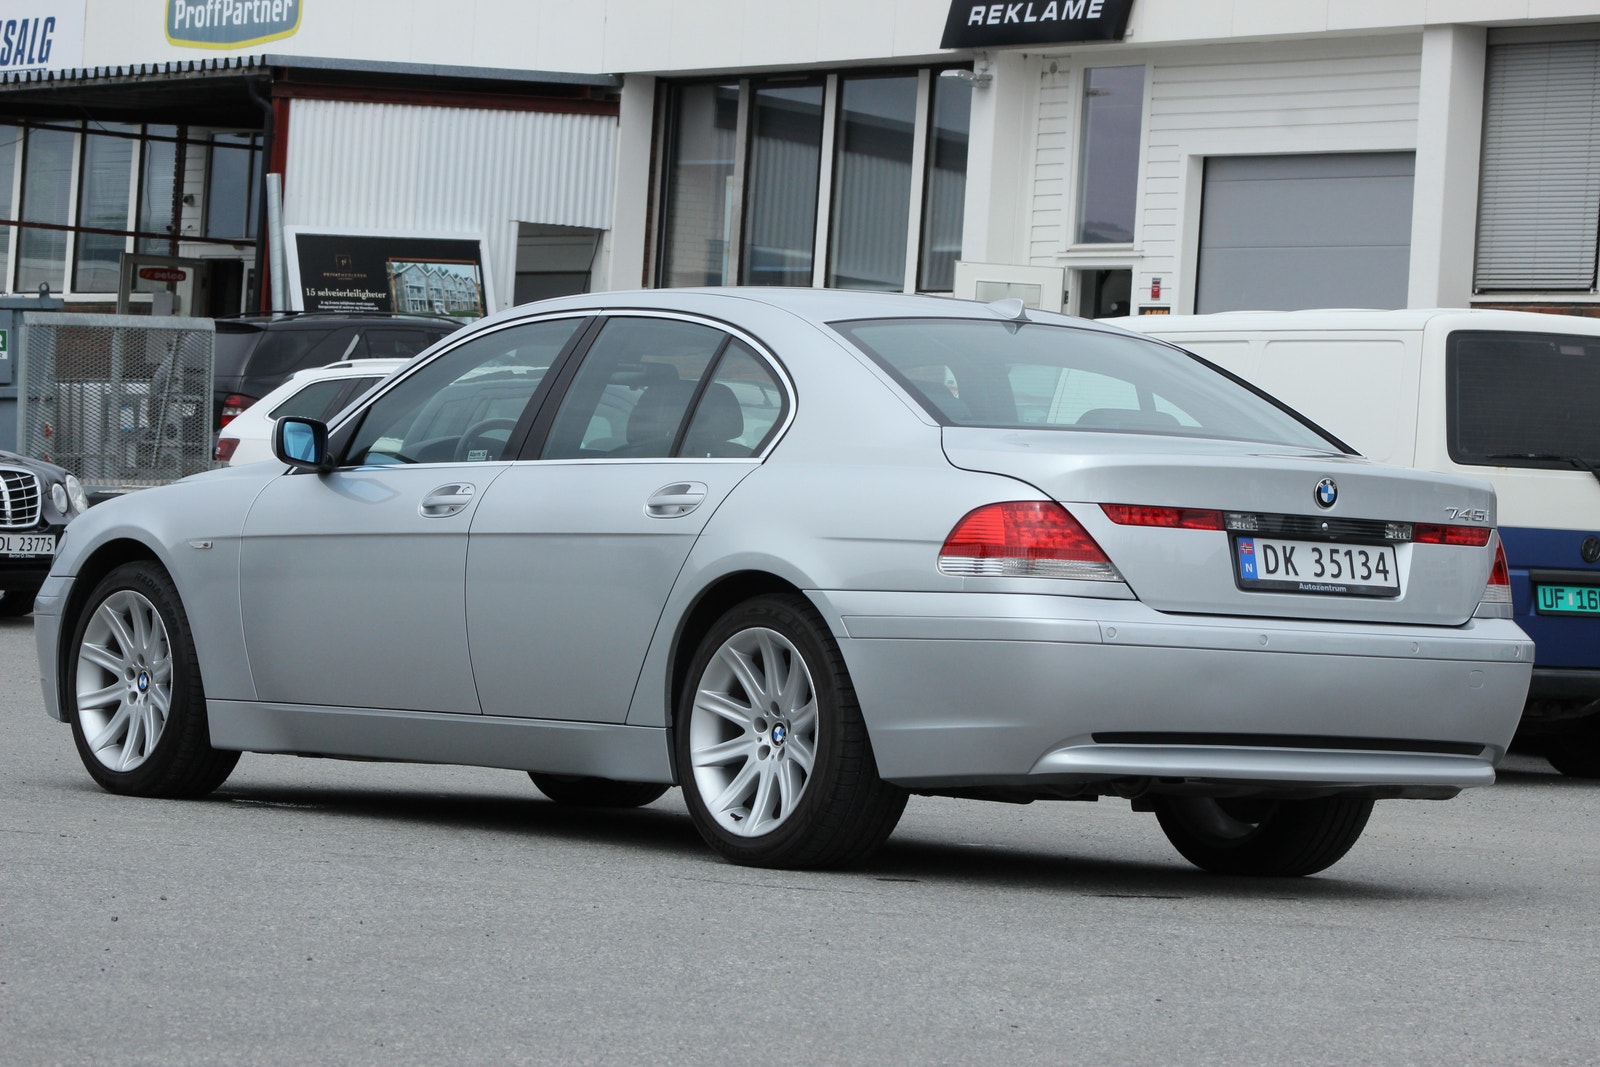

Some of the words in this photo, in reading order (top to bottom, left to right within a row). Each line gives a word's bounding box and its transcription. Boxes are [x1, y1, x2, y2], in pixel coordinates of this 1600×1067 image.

[174, 0, 293, 29] ProffPartner
[967, 0, 1104, 26] REKLAME
[0, 16, 56, 66] SALG
[306, 288, 316, 297] 15
[318, 288, 386, 300] selveierleiligheter
[1444, 506, 1490, 523] 745i
[19, 536, 53, 552] 23775
[1245, 563, 1253, 573] N
[1262, 544, 1299, 576] DK
[1311, 547, 1390, 582] 35134
[1299, 582, 1347, 593] Autozentrum
[1542, 587, 1565, 609] UF
[1576, 589, 1600, 611] 16
